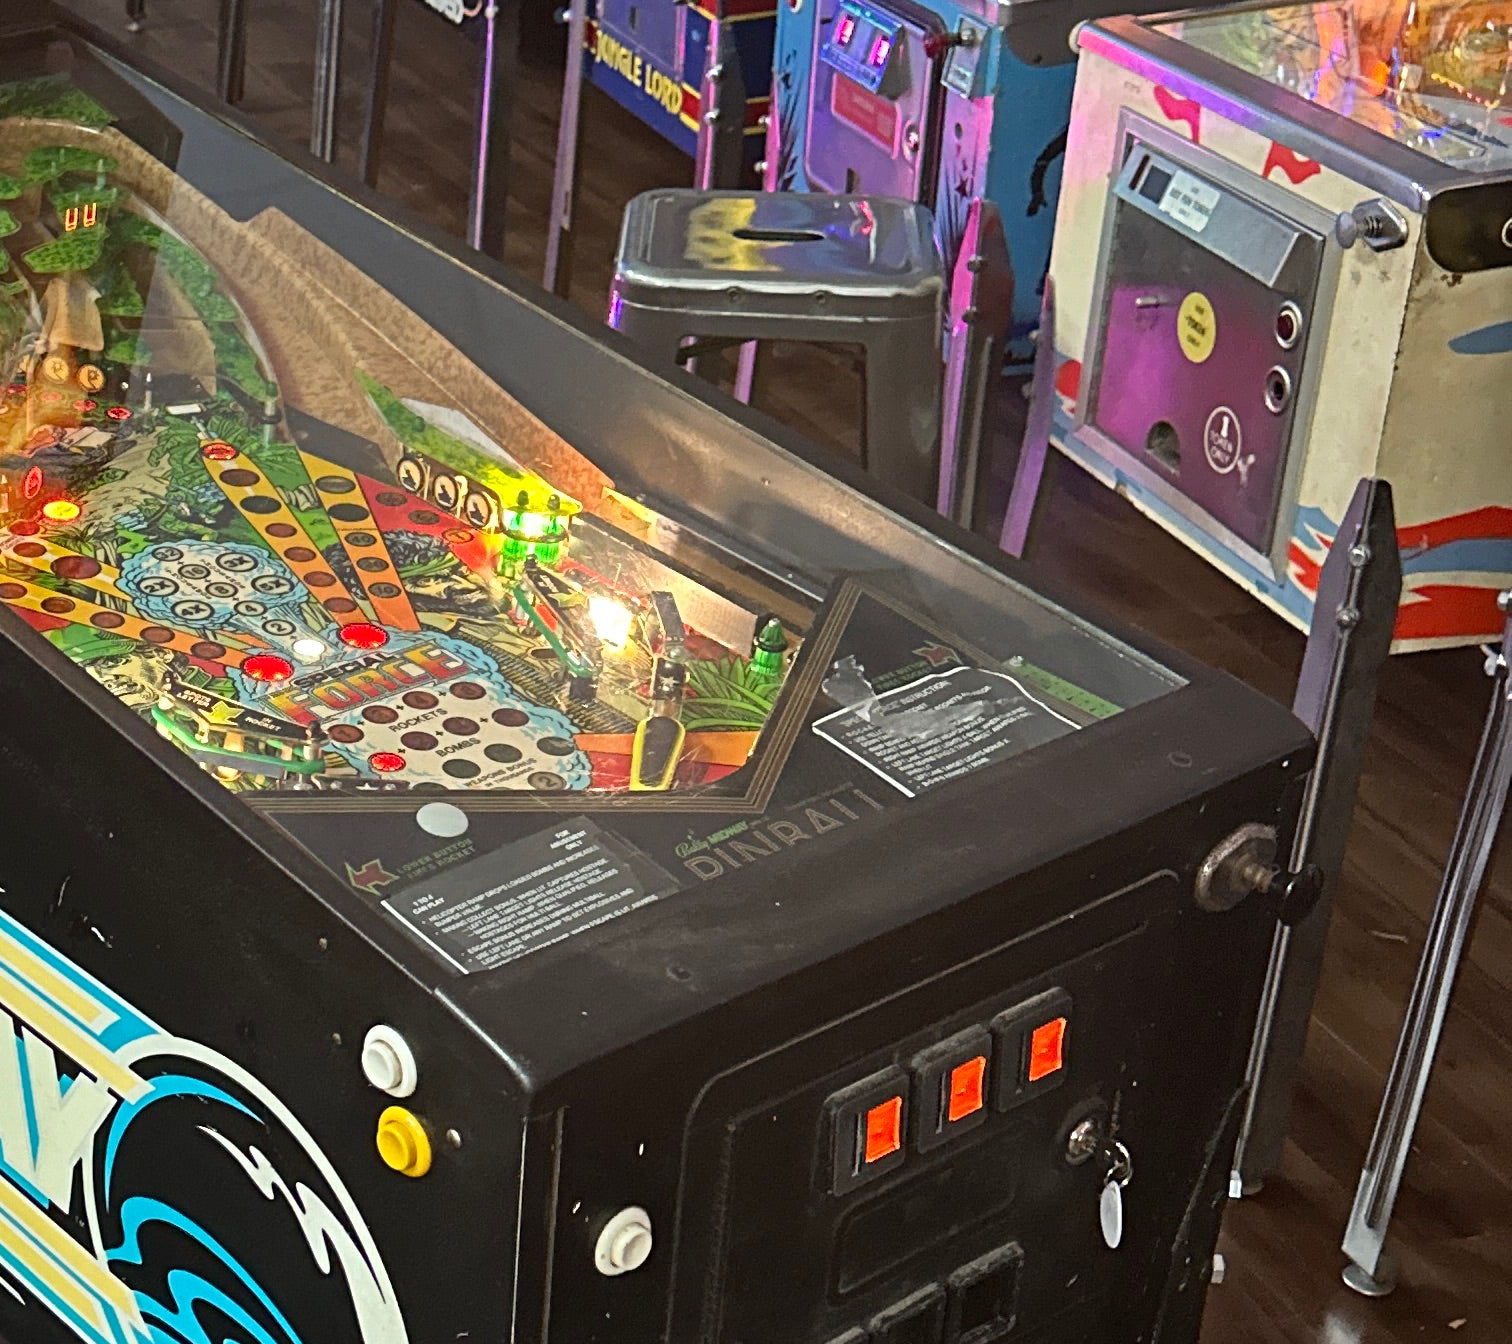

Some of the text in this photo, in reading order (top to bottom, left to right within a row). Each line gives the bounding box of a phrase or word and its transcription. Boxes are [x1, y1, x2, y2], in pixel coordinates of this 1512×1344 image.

[595, 29, 683, 116] JUNGLE LORD
[267, 643, 473, 726] FORCE
[294, 652, 399, 689] SPECIAL
[388, 707, 449, 733] ROCKETS
[435, 737, 481, 758] BOMBS
